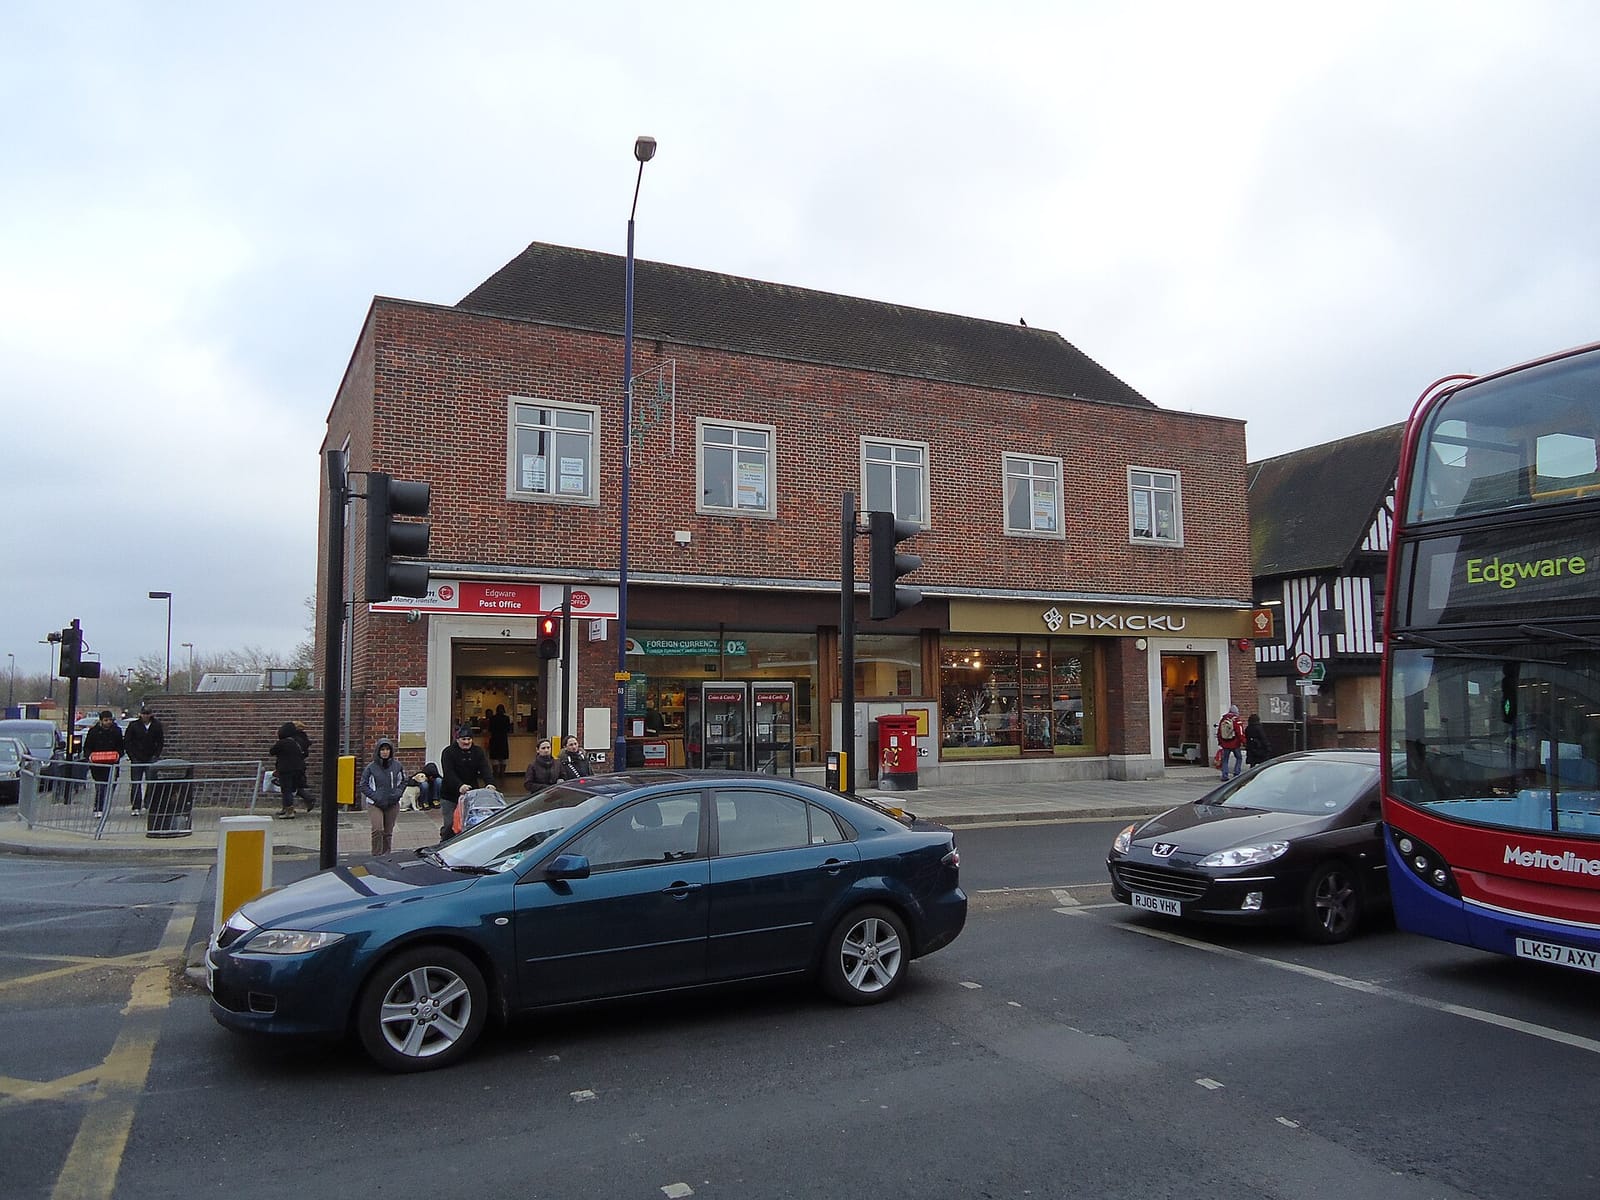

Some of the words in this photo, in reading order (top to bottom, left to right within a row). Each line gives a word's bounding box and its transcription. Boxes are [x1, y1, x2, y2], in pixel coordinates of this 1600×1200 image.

[1467, 556, 1586, 589] Edgware
[485, 588, 517, 598] Edgware
[479, 599, 497, 608] Post
[498, 599, 522, 609] Office
[1069, 612, 1187, 631] PIXICKU
[500, 629, 511, 637] 42
[646, 640, 678, 648] FOREIGN
[679, 640, 717, 648] CURRENCY
[727, 640, 745, 654] 0%
[1503, 844, 1600, 876] Metroline
[1135, 894, 1158, 909] RJ06
[1522, 940, 1562, 961] LK57
[1567, 949, 1597, 968] AXY
